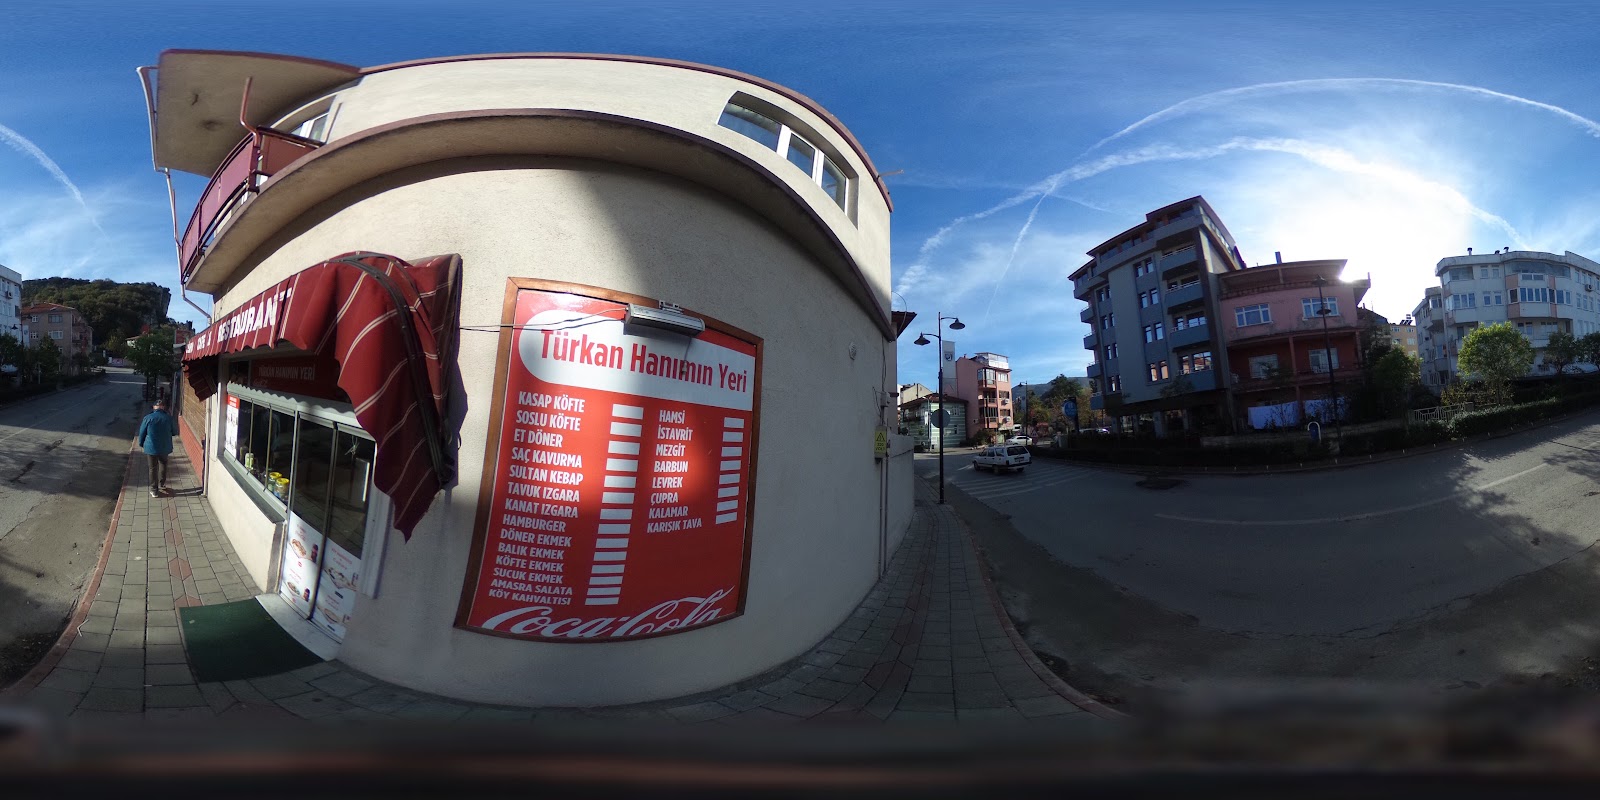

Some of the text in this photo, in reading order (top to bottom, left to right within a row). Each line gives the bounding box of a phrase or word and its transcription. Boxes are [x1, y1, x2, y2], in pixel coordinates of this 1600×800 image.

[541, 329, 747, 392] Türkan Hanımın Yeri
[518, 391, 585, 412] KASAP KÖFTE
[516, 410, 581, 431] SOSLU KÖFTE
[659, 410, 685, 424] HAMSİ
[514, 429, 563, 447] ET DÖNER
[658, 425, 693, 441] İSTAVRİT
[512, 447, 582, 468] SAÇ KAVURMA
[656, 443, 685, 456] MEZGİT
[509, 465, 583, 485] SULTAN KEBAP
[654, 461, 688, 472] BARBUN
[652, 477, 683, 488] LEVREK
[508, 482, 580, 502] TAVUK IZGARA
[650, 492, 678, 506] ÇUPRA
[505, 498, 578, 518] KANAT IZGARA
[649, 506, 688, 519] KALAMAR
[503, 514, 566, 532] HAMBURGER
[647, 518, 702, 533] KARIŞIK TAVA
[500, 528, 572, 547] DÖNER EKMEK
[498, 542, 565, 560] BALIK EKMEK
[496, 555, 563, 572] KÖFTE EKMEK
[493, 568, 563, 584] SUCUK EKMEK
[491, 579, 572, 595] AMASRA SALATA
[489, 589, 571, 605] KÖY KAHVALTISI
